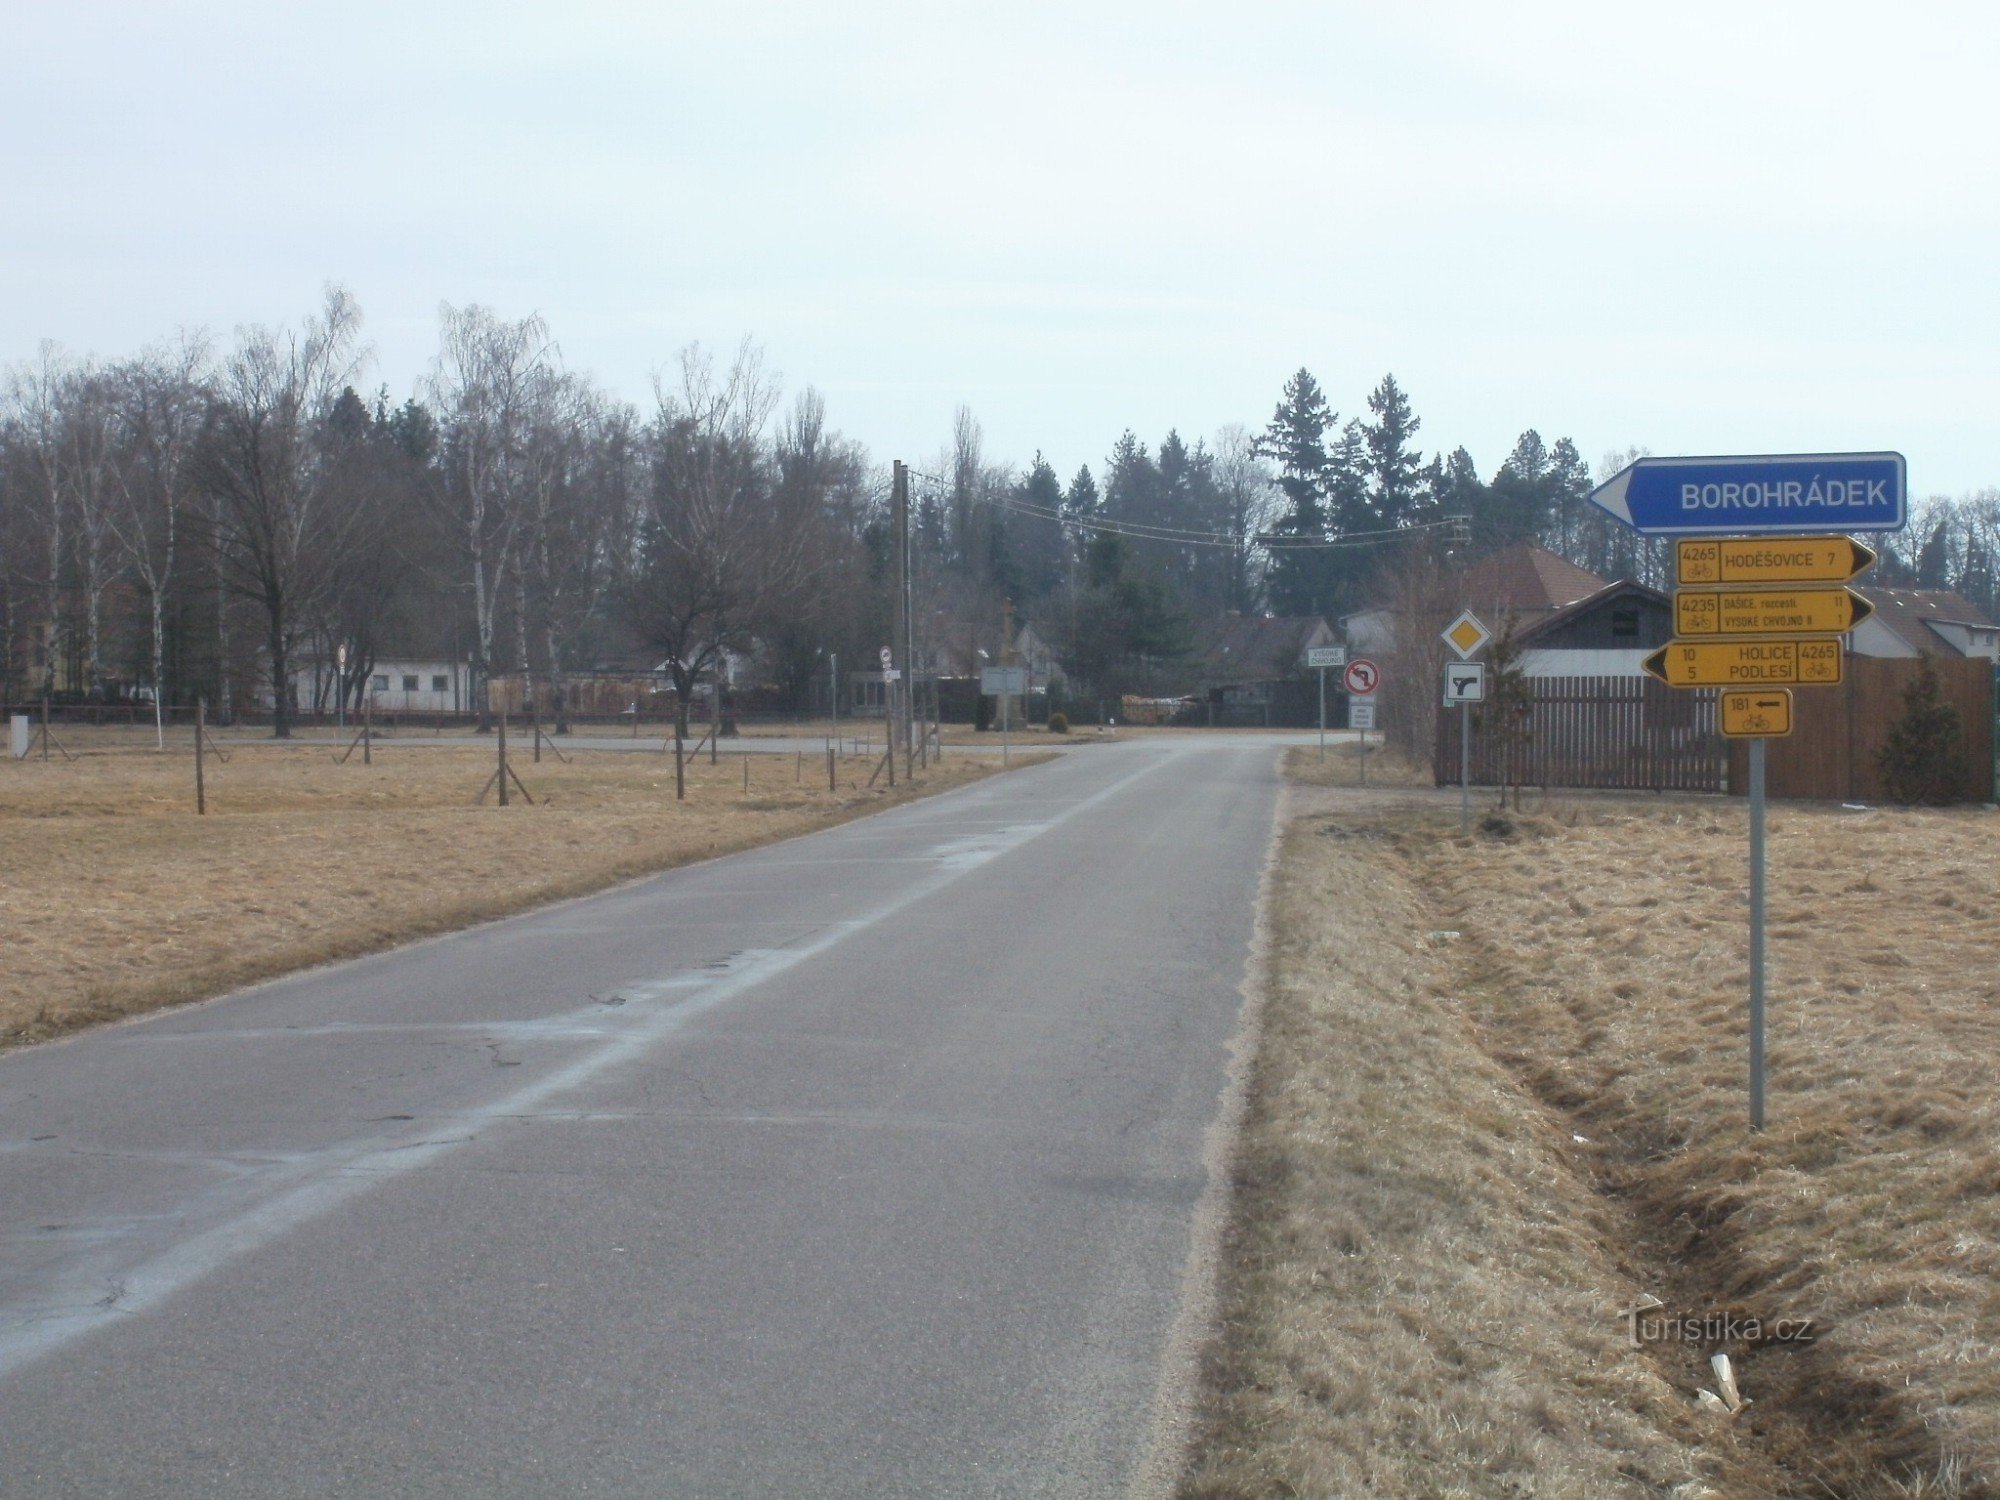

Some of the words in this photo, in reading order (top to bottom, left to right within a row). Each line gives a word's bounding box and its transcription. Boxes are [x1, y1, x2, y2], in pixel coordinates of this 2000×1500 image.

[1681, 474, 1888, 509] BOROHRÁDEK
[1682, 547, 1716, 561] 4265
[1725, 550, 1814, 567] HODĚŠOVICE
[1827, 552, 1835, 565] 7
[1681, 599, 1715, 612] 4235
[1834, 596, 1843, 607] 11
[1763, 614, 1803, 627] CHVOJNO
[1837, 615, 1842, 625] 1
[1682, 648, 1696, 661] 10
[1739, 646, 1792, 660] HOLICE
[1801, 645, 1835, 659] 4265
[1688, 666, 1696, 679] 5
[1729, 662, 1792, 679] PODLESÍ
[1731, 698, 1749, 711] 181
